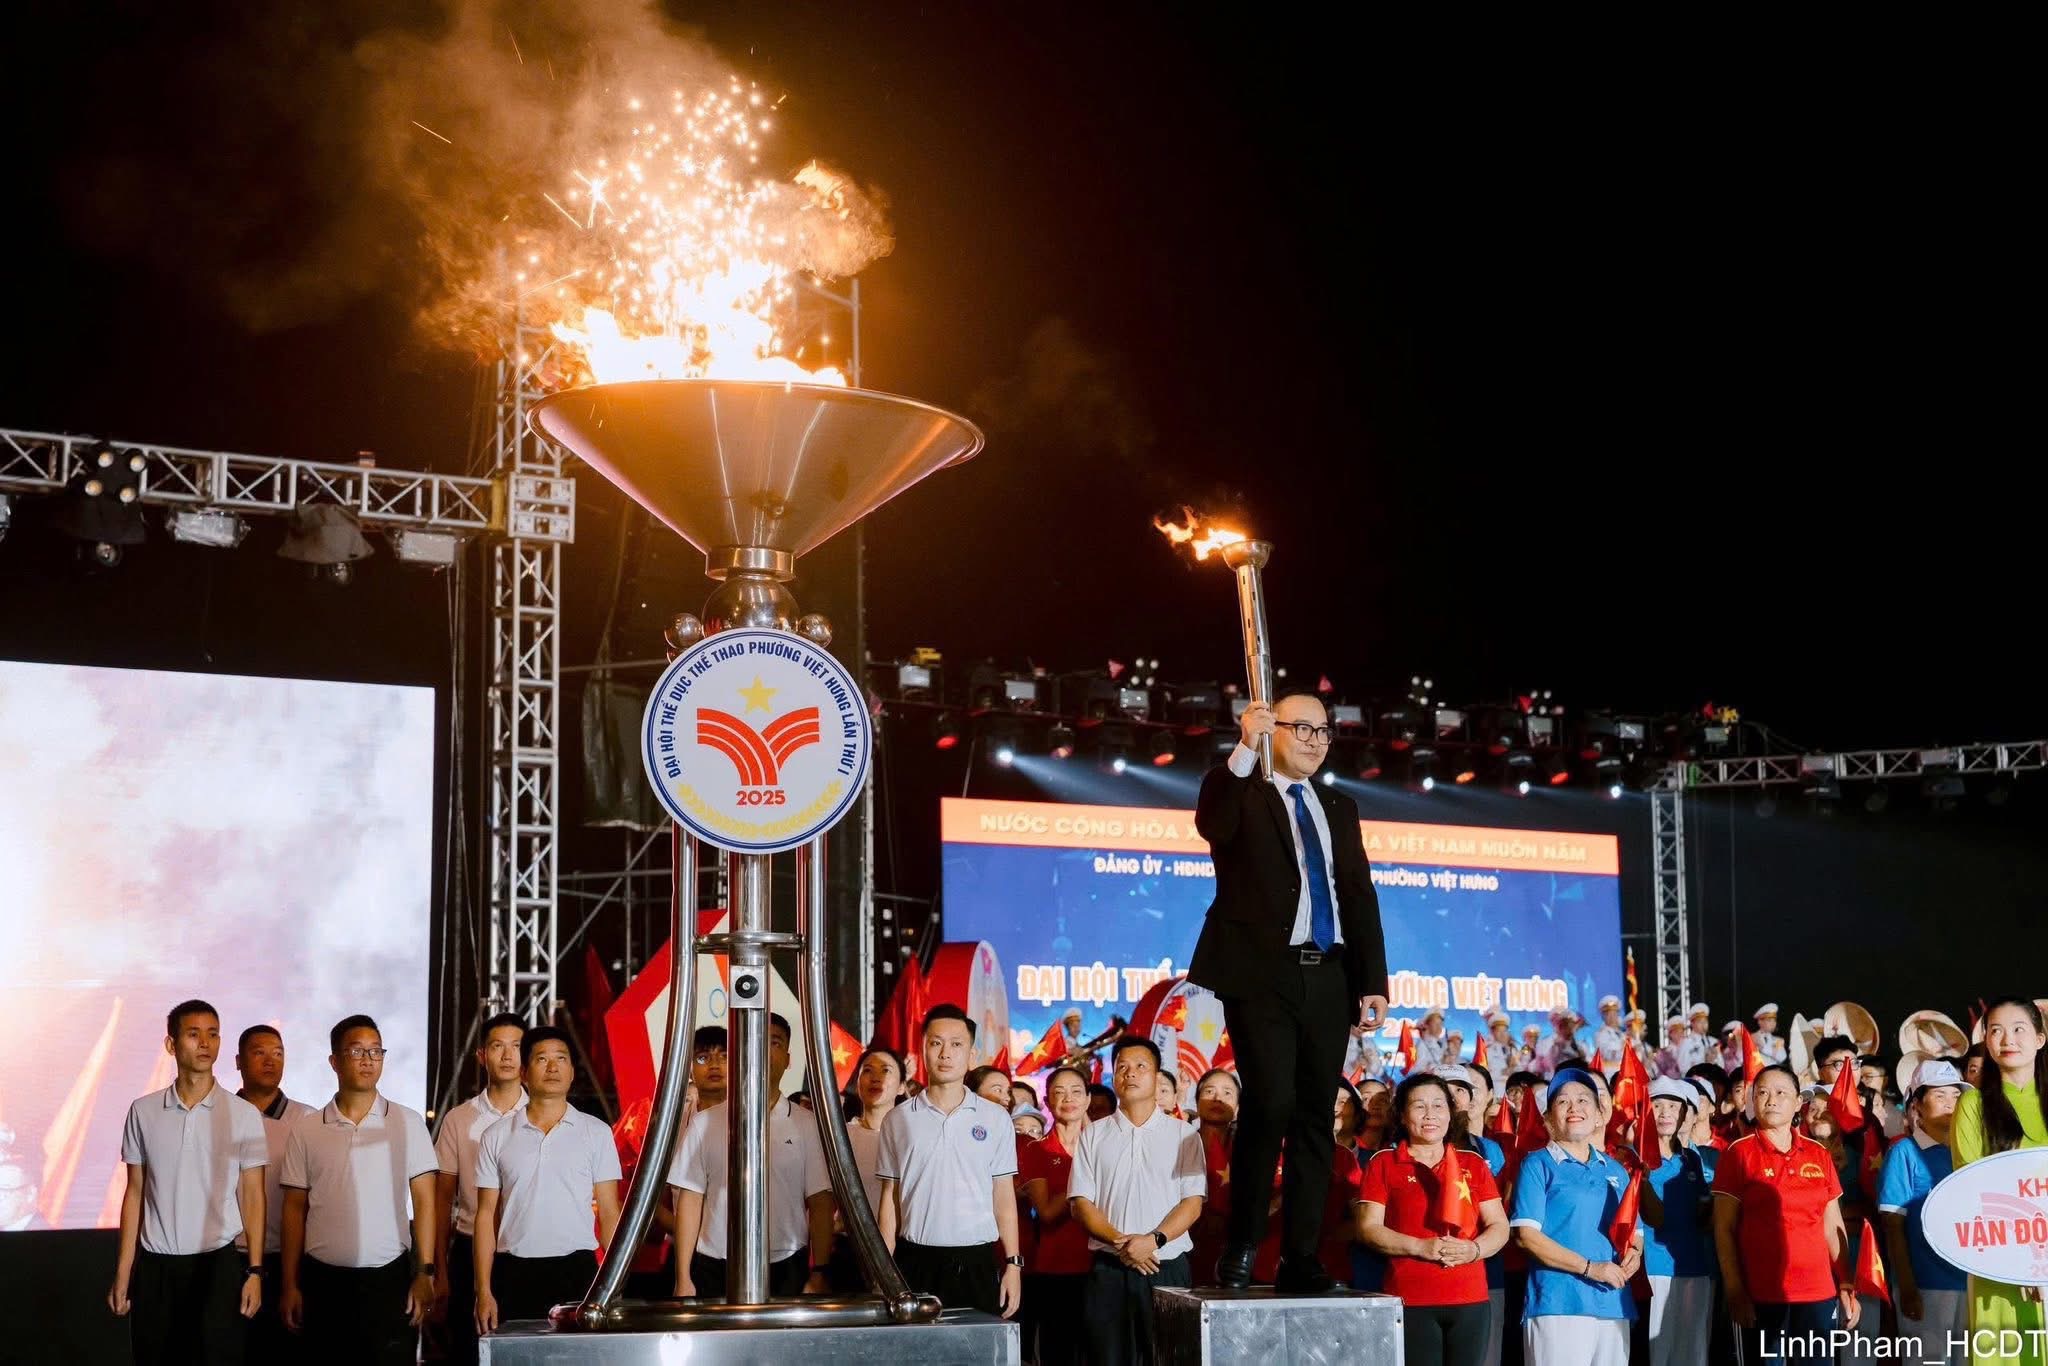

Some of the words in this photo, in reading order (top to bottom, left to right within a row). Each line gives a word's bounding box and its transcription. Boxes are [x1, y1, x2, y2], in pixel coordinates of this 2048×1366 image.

[711, 642, 745, 663] THAO
[749, 641, 802, 663] PHƯỜNG
[688, 652, 712, 679] THỂ
[803, 655, 830, 679] VIỆT
[669, 675, 692, 702] DỤC
[825, 677, 851, 711] HƯNG
[661, 699, 678, 726] THỂ
[841, 711, 861, 738] LẦN
[657, 730, 676, 752] HỘI
[663, 755, 682, 779] ĐẠI
[841, 743, 857, 770] THỨ
[736, 790, 786, 806] 2025
[980, 813, 1049, 834] NƯỚC
[1055, 815, 1125, 839] CỘNG
[1389, 833, 1427, 856] VIỆT
[1432, 837, 1476, 855] NAM
[1481, 839, 1538, 859] MUÔN
[1094, 852, 1140, 874] ĐẢNG
[1430, 870, 1458, 892] VIỆT
[1459, 873, 1498, 891] HƯNG
[1016, 964, 1066, 1007] ĐẠI
[1070, 960, 1118, 1008] HỘI
[1450, 972, 1503, 1016] VIỆT
[1505, 975, 1569, 1013] HƯNG
[1954, 1215, 2007, 1253] VẬN
